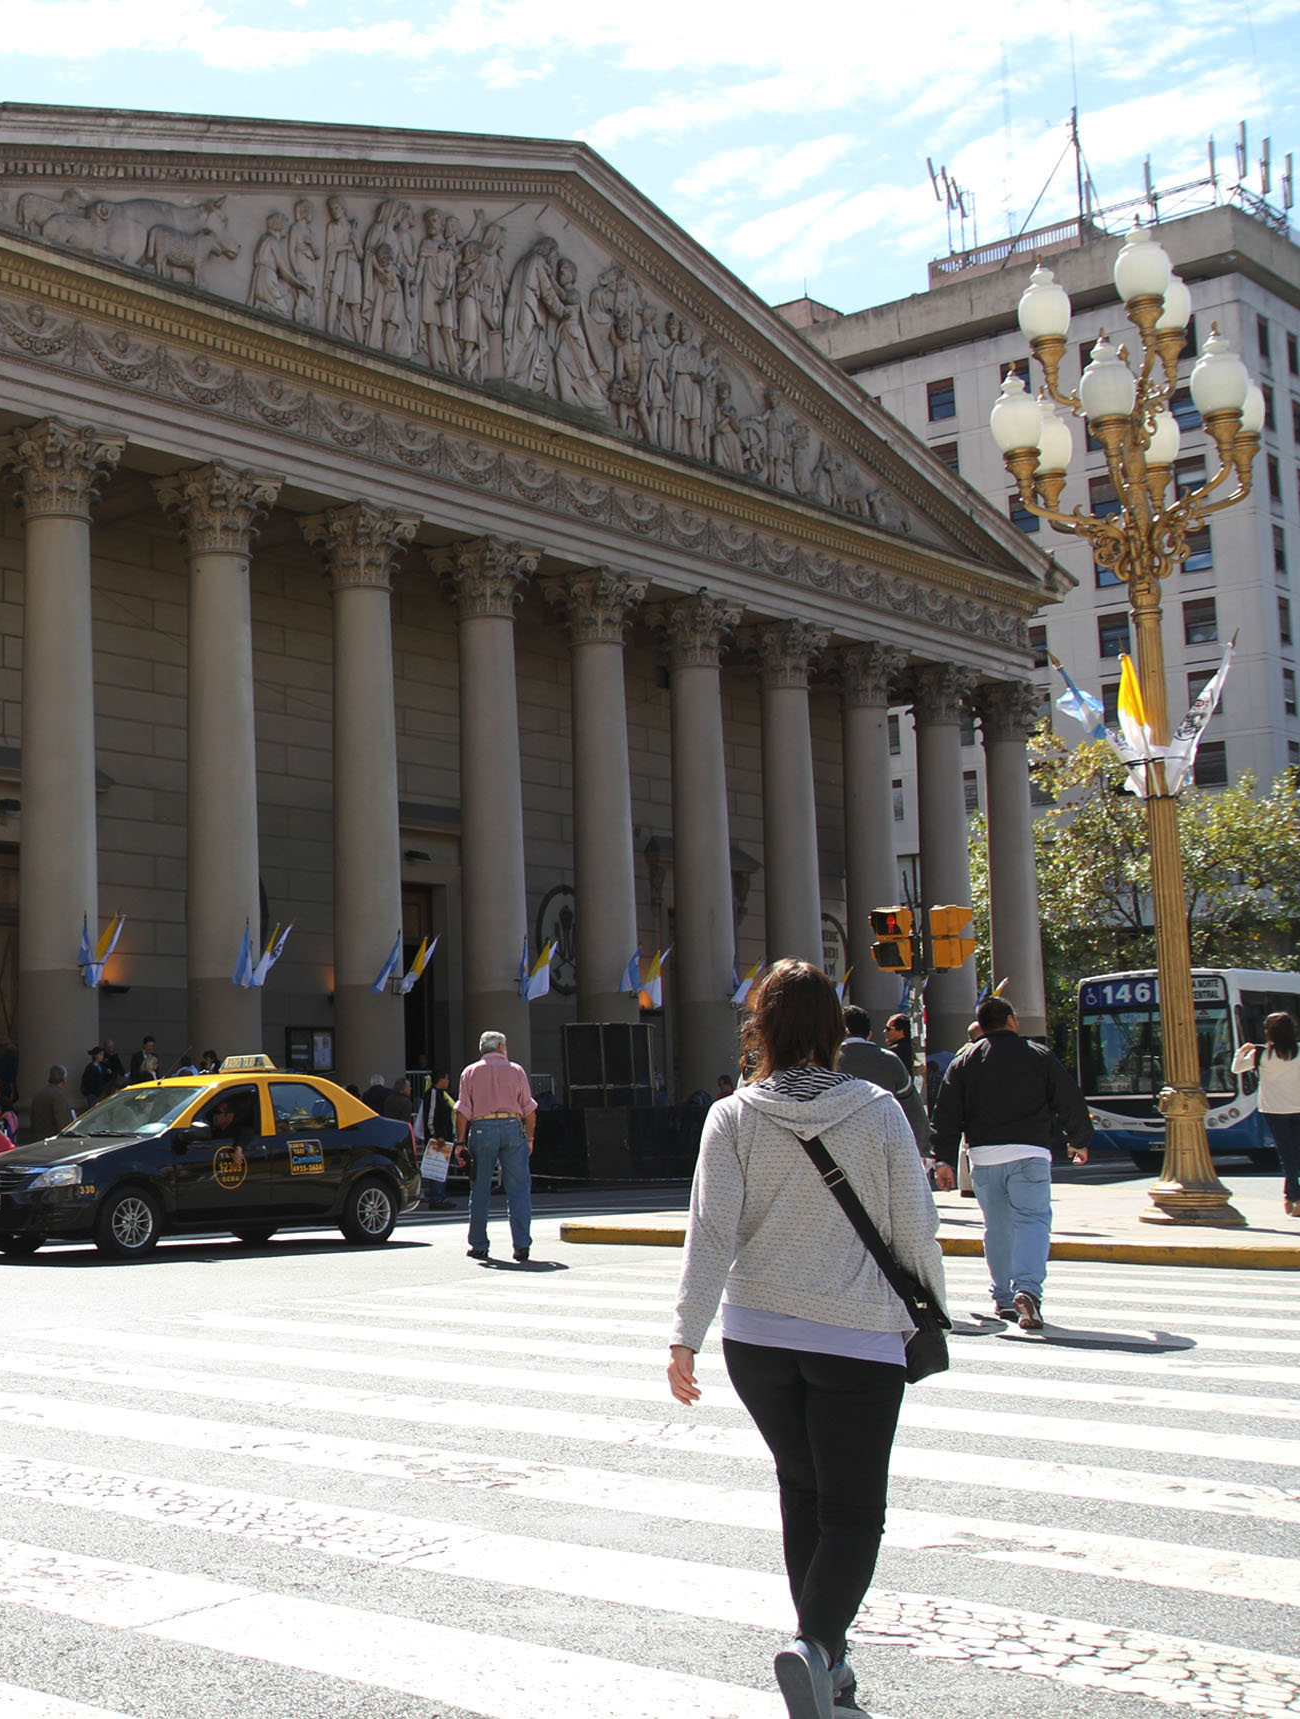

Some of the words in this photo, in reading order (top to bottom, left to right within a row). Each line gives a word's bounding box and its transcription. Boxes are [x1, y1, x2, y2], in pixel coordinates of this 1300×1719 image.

[1102, 982, 1151, 1004] 146
[1193, 990, 1219, 999] ENTRAL
[80, 1185, 95, 1195] 330
